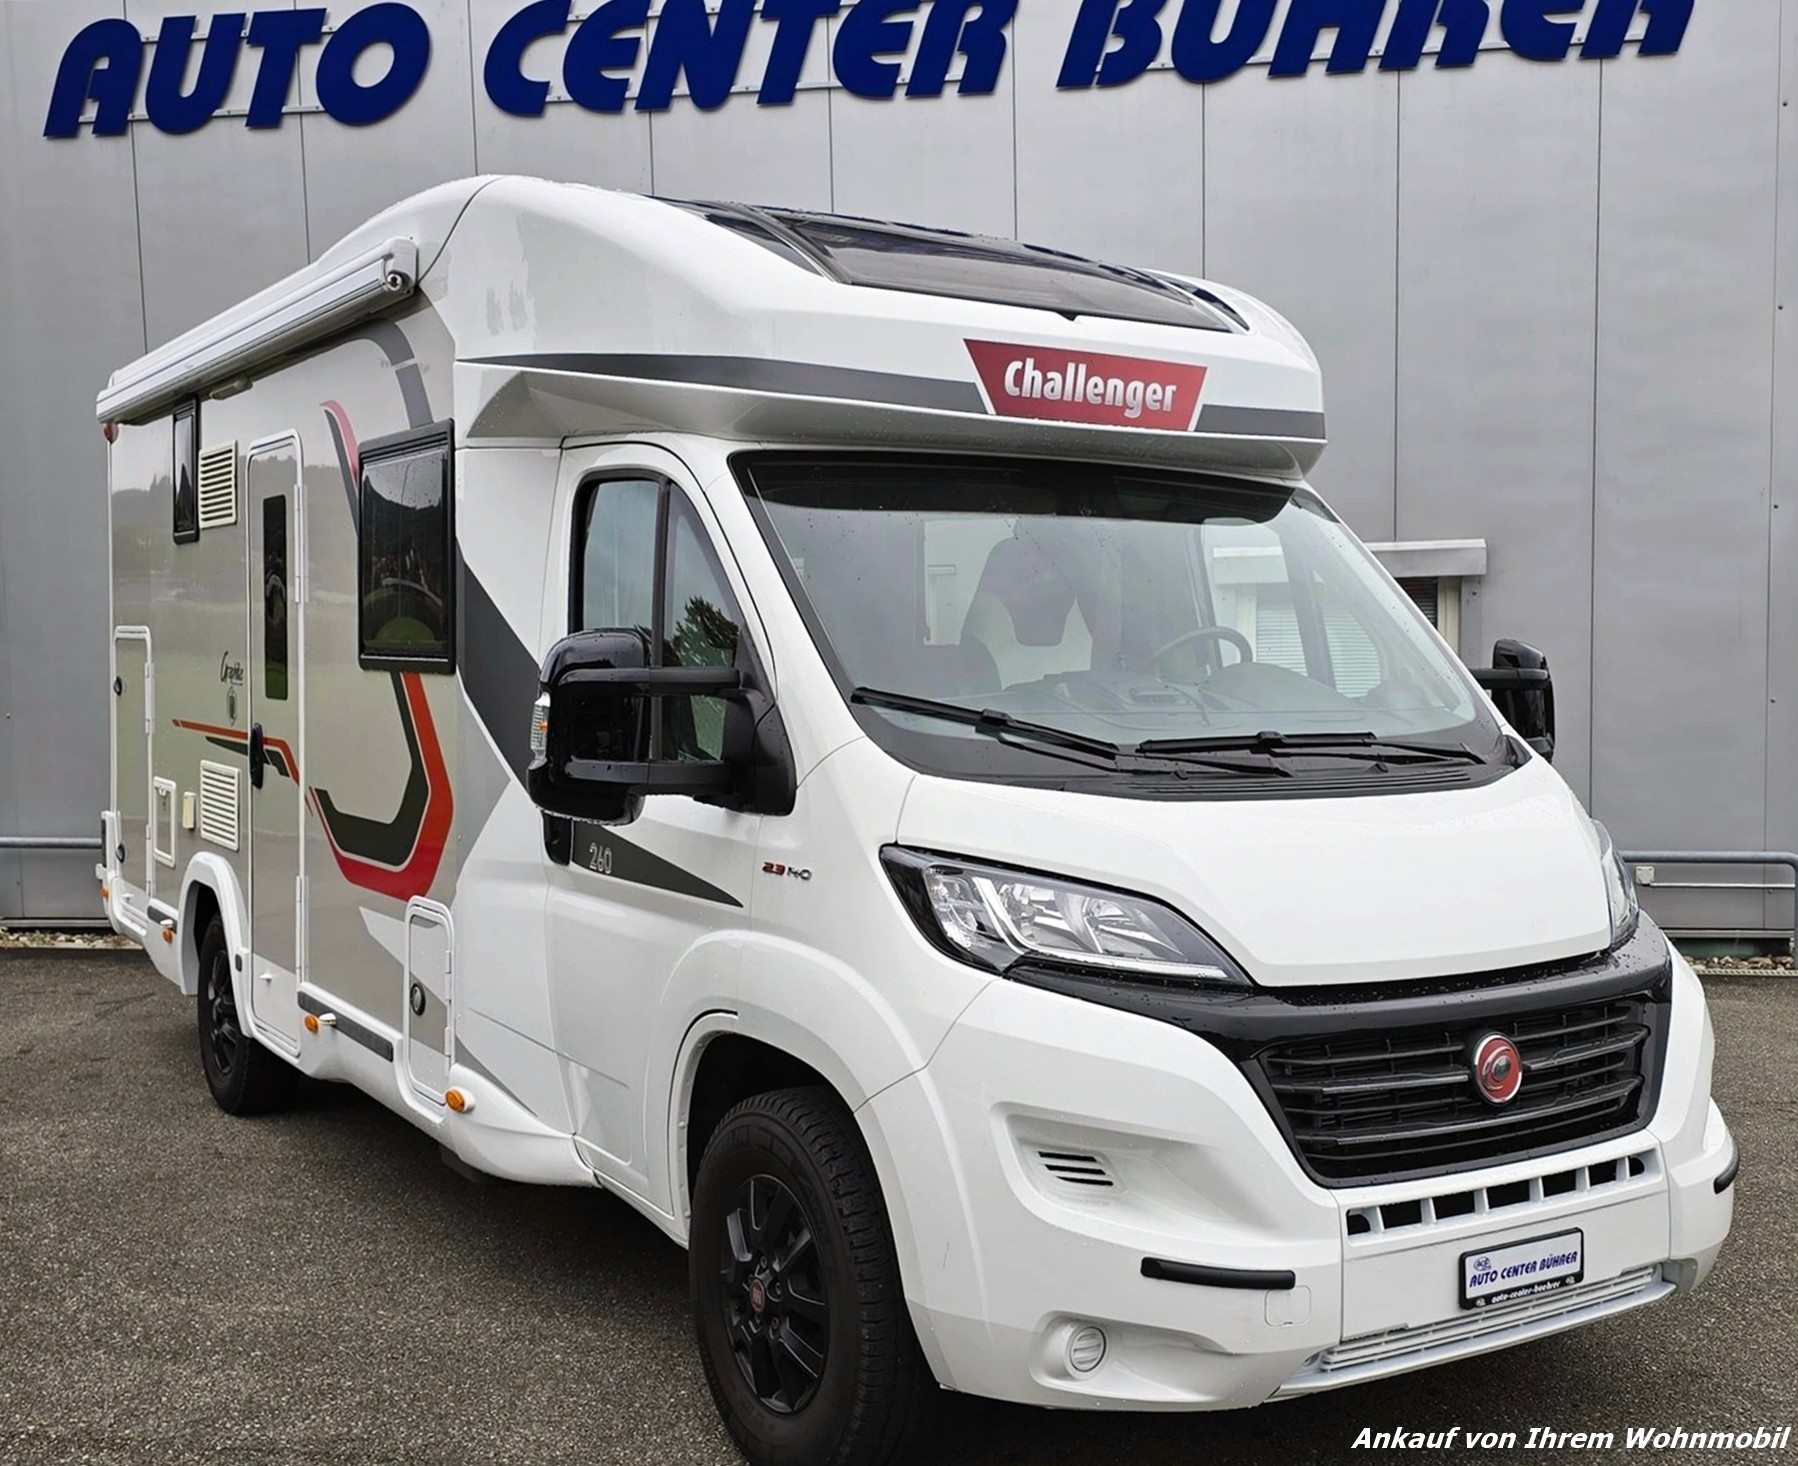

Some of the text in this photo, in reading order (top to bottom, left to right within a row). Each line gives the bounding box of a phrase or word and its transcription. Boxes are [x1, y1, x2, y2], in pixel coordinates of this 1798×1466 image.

[43, 2, 430, 138] AUTO
[483, 0, 1018, 117] CENTER
[1004, 357, 1177, 418] Challenger
[589, 842, 612, 874] 260
[1469, 1270, 1498, 1288] AUTO
[1501, 1261, 1537, 1279] CENTER
